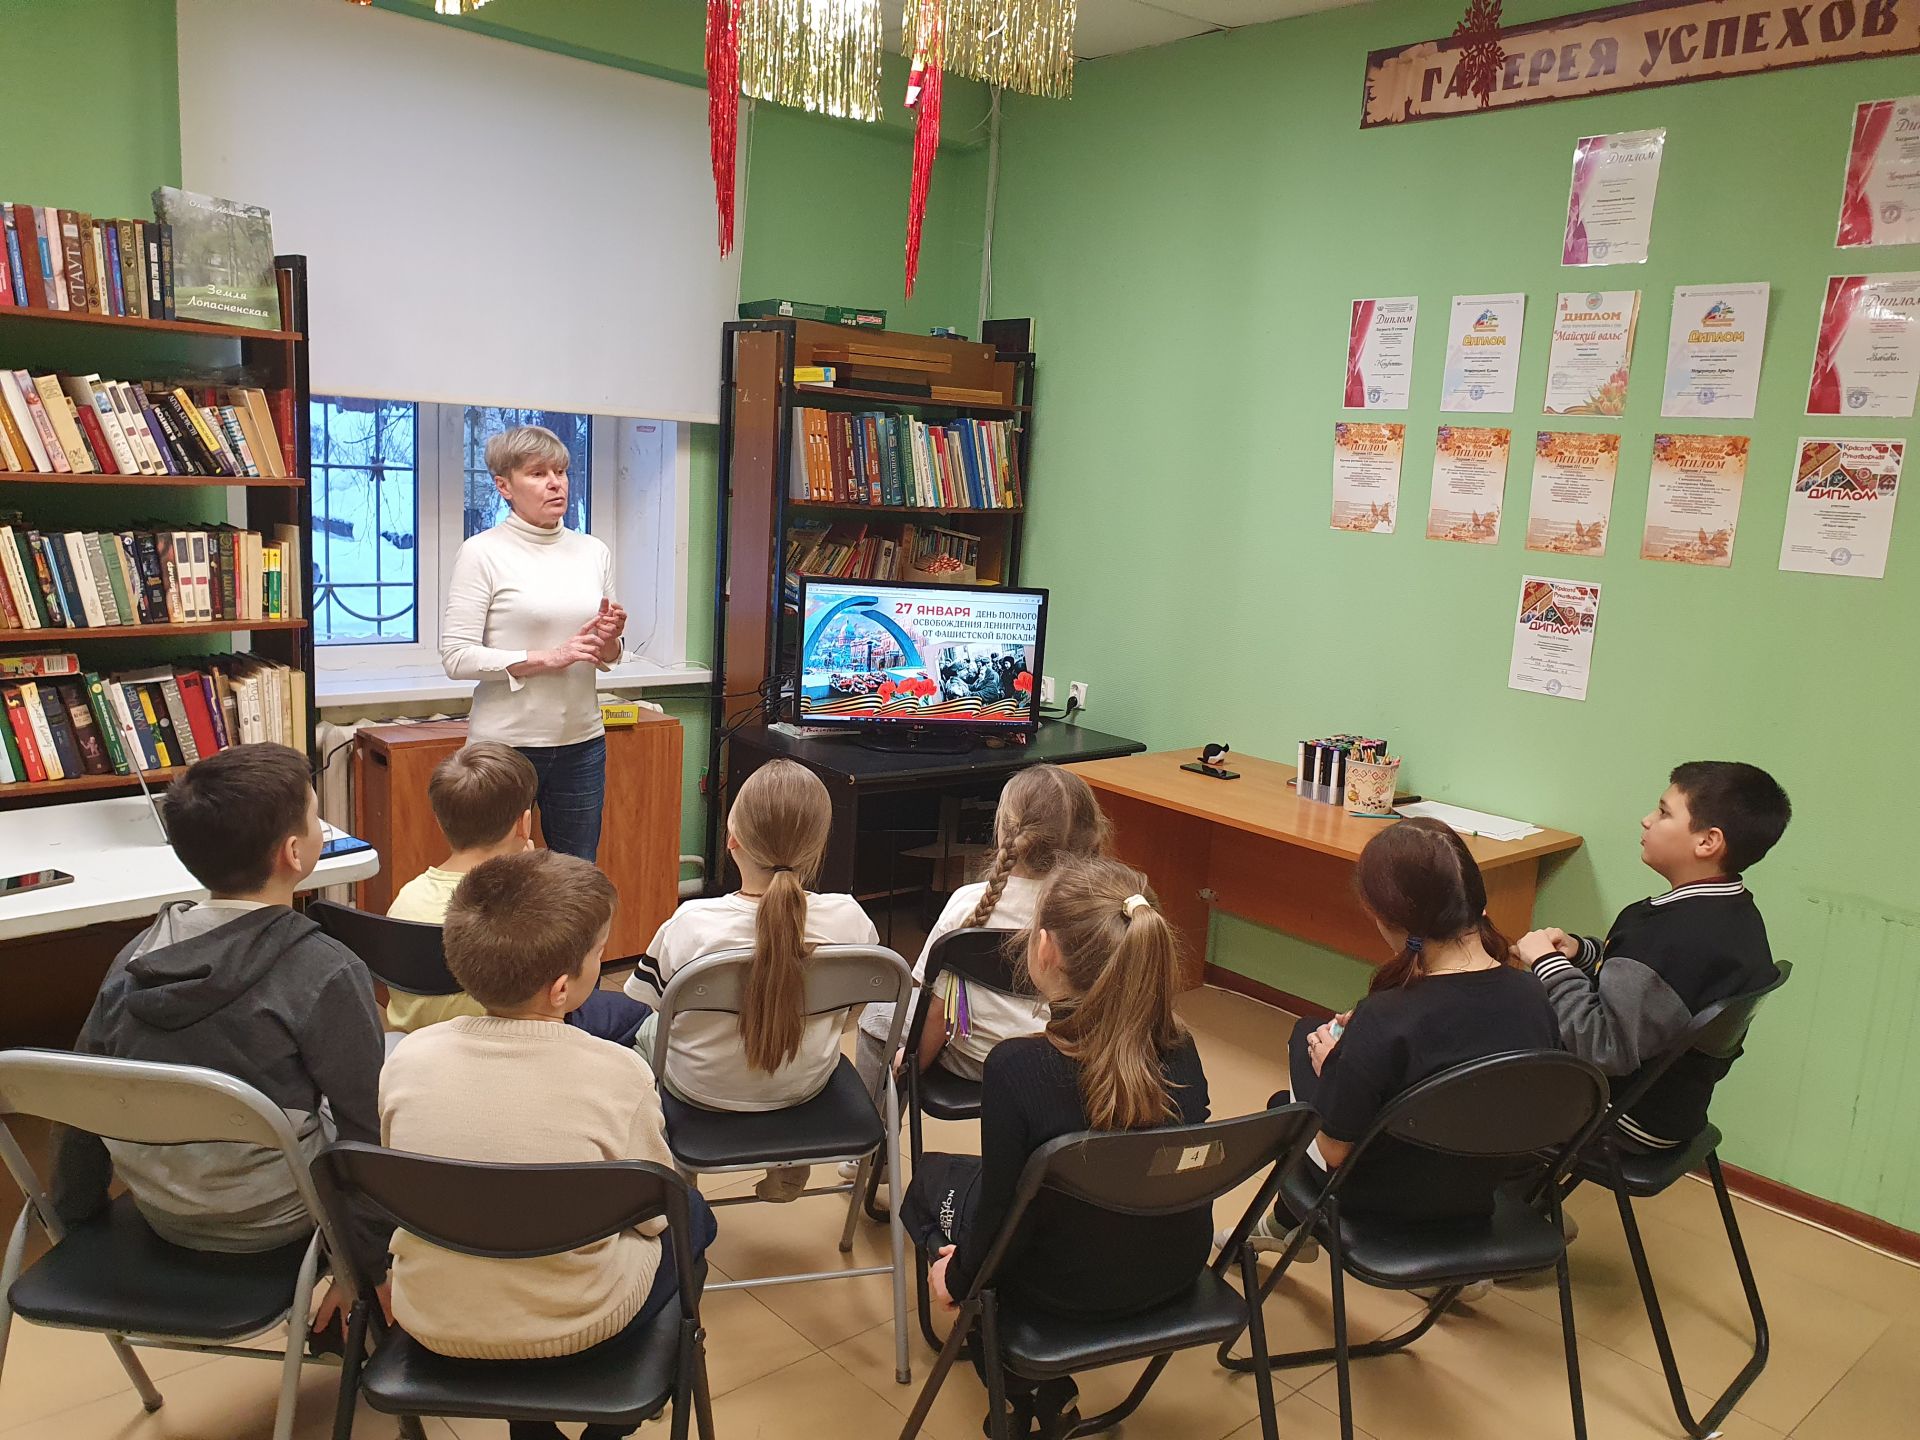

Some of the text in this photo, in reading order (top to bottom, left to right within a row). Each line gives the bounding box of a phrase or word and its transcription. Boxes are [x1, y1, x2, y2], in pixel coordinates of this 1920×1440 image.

[1639, 0, 1898, 77] УСПЕХОВ
[1607, 152, 1655, 165] Диплом
[64, 247, 88, 308] СТАУТ
[207, 284, 248, 300] Земля
[187, 295, 270, 318] Лопасненская
[1376, 313, 1413, 325] Диплом
[1563, 312, 1622, 322] ДИПЛОМ
[889, 450, 899, 488] БОЛЬШОЙ
[1807, 487, 1878, 502] ДИПЛОМ
[895, 603, 1037, 620] 27 ЯНВАРЯ ДЕНЬ ПОЛНОГО
[913, 618, 1036, 632] ОСВОБОЖДЕНИЯ ЛЕНИНГРАДА
[1529, 621, 1581, 636] ДИПЛОМ
[922, 629, 1036, 642] ОТ ФАШИСТСКОЙ БЛОКАДЫ
[248, 680, 259, 702] Рой
[131, 706, 148, 730] МАРК
[1190, 1150, 1200, 1163] 4
